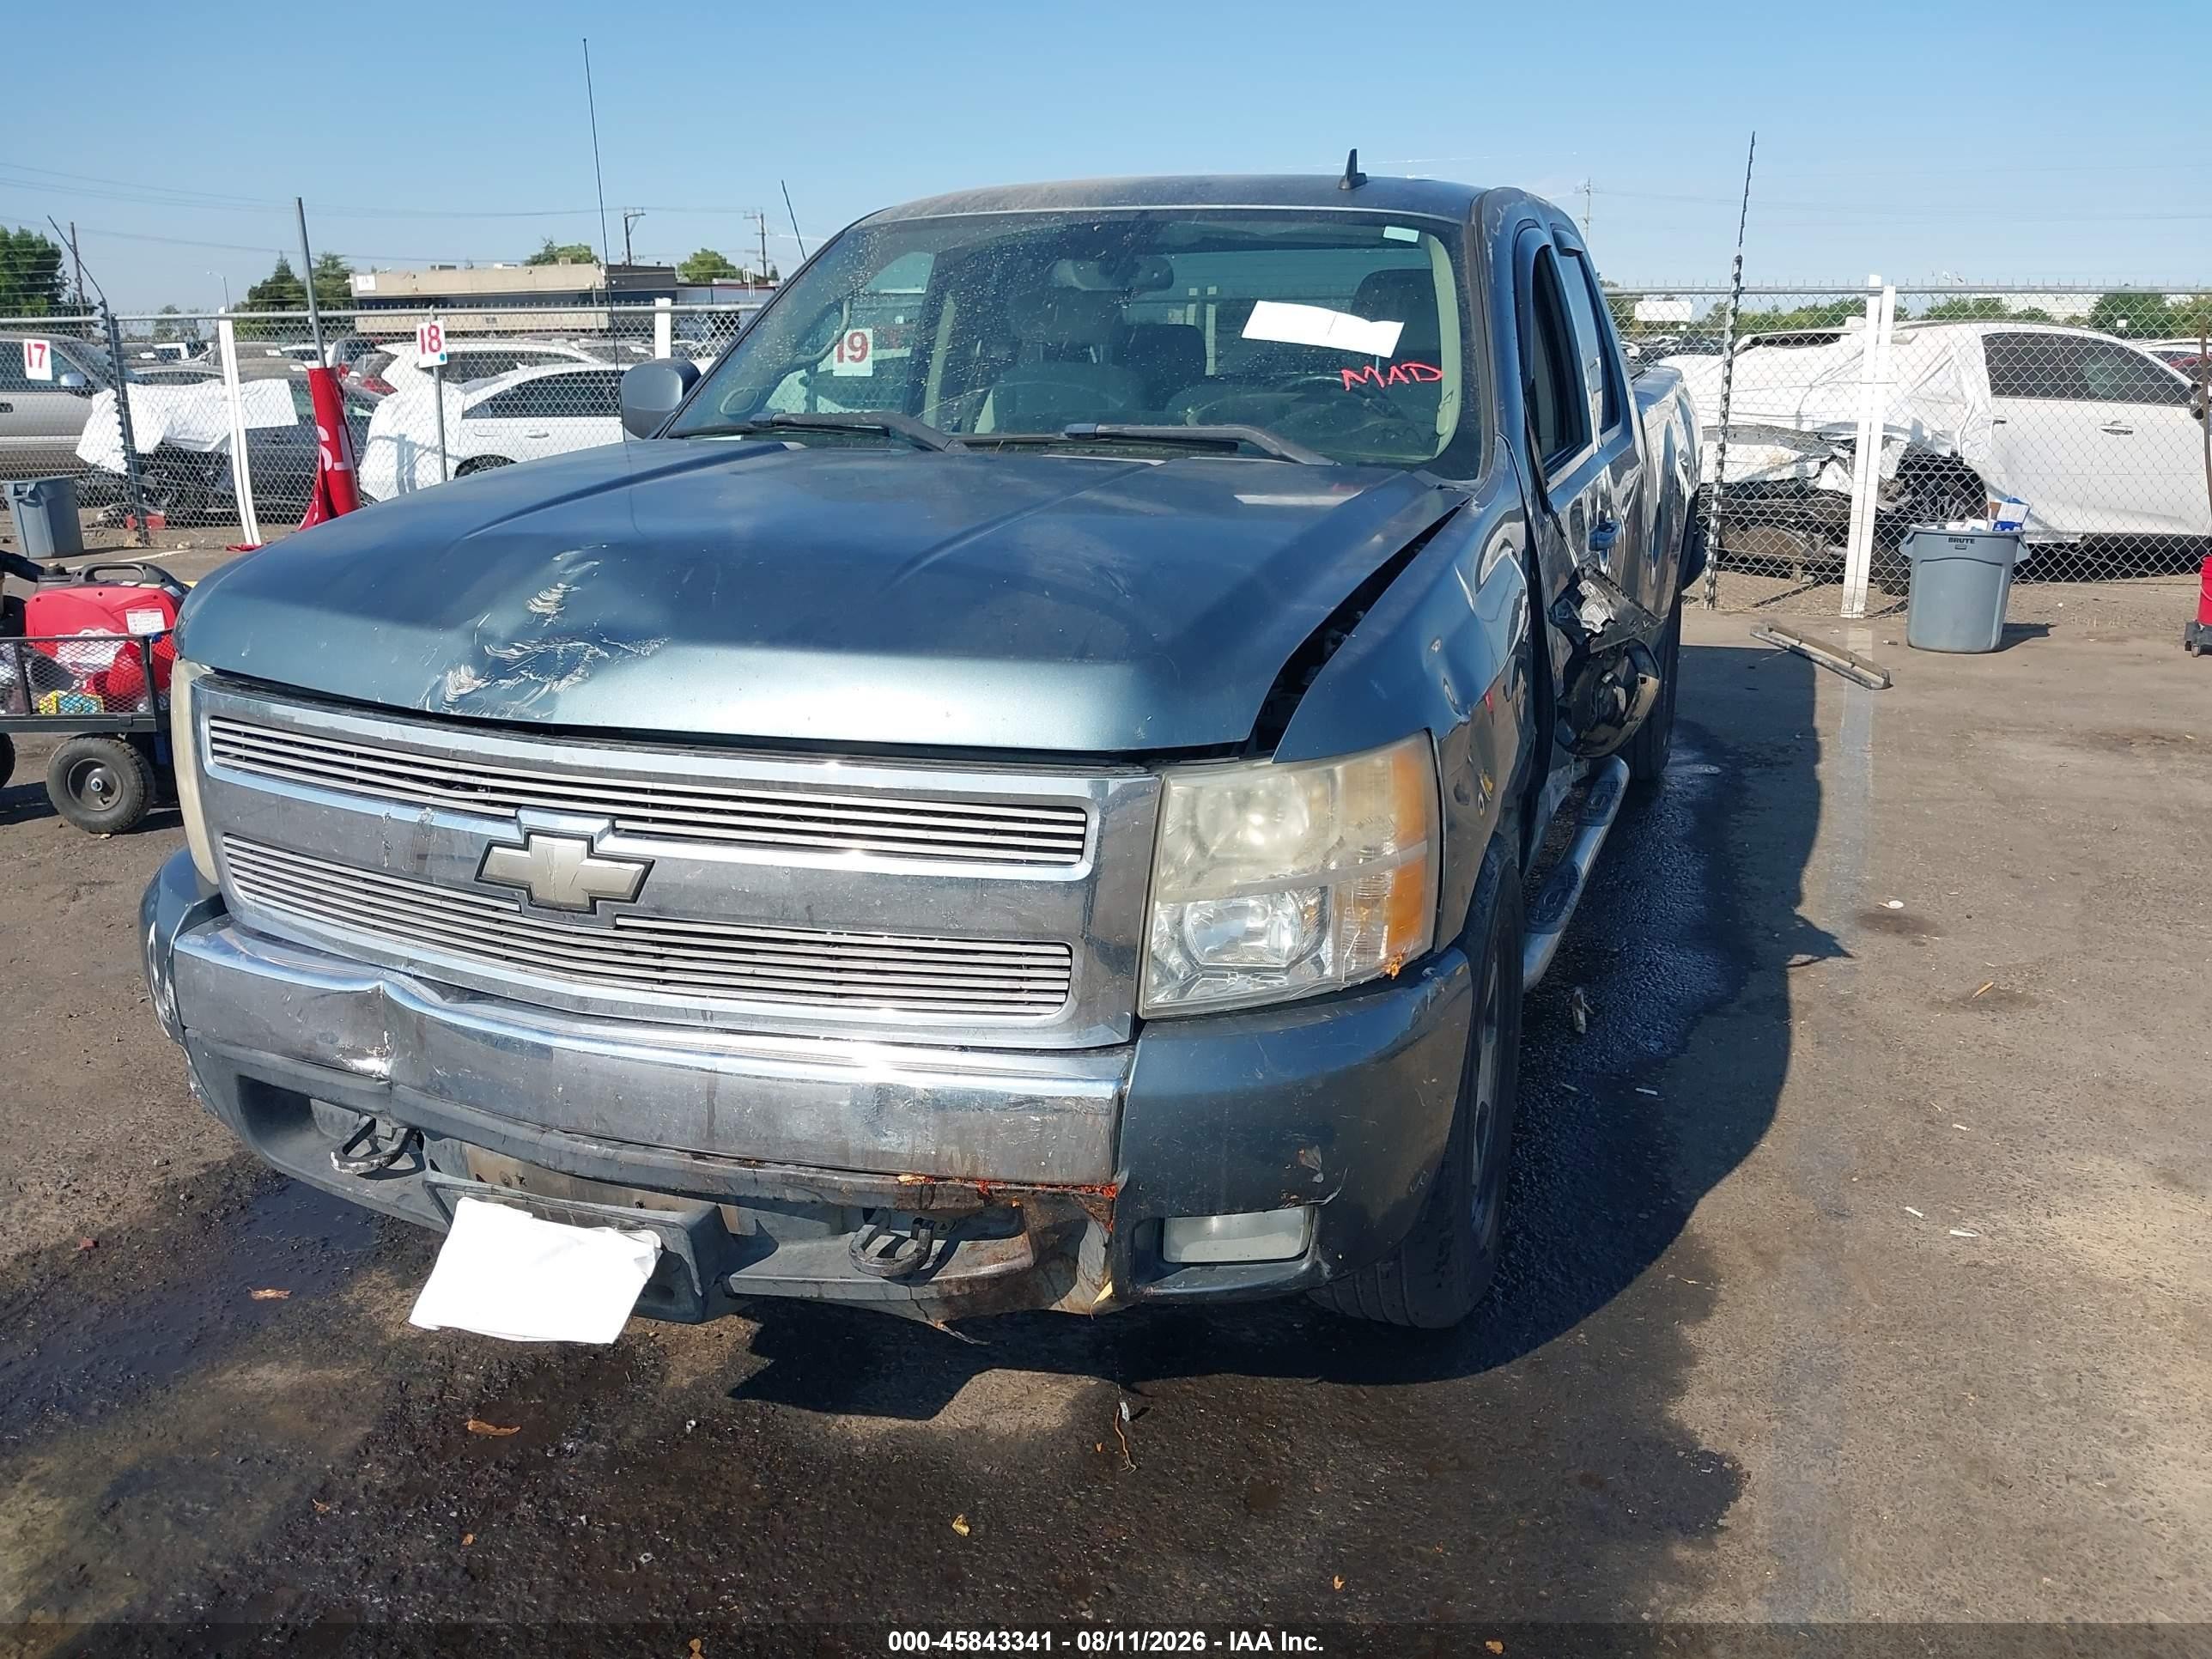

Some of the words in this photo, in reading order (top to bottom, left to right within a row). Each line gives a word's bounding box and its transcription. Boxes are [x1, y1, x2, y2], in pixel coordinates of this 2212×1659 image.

[420, 325, 442, 355] 18
[836, 331, 868, 363] 19
[27, 343, 46, 369] 17
[1341, 362, 1443, 392] MAD
